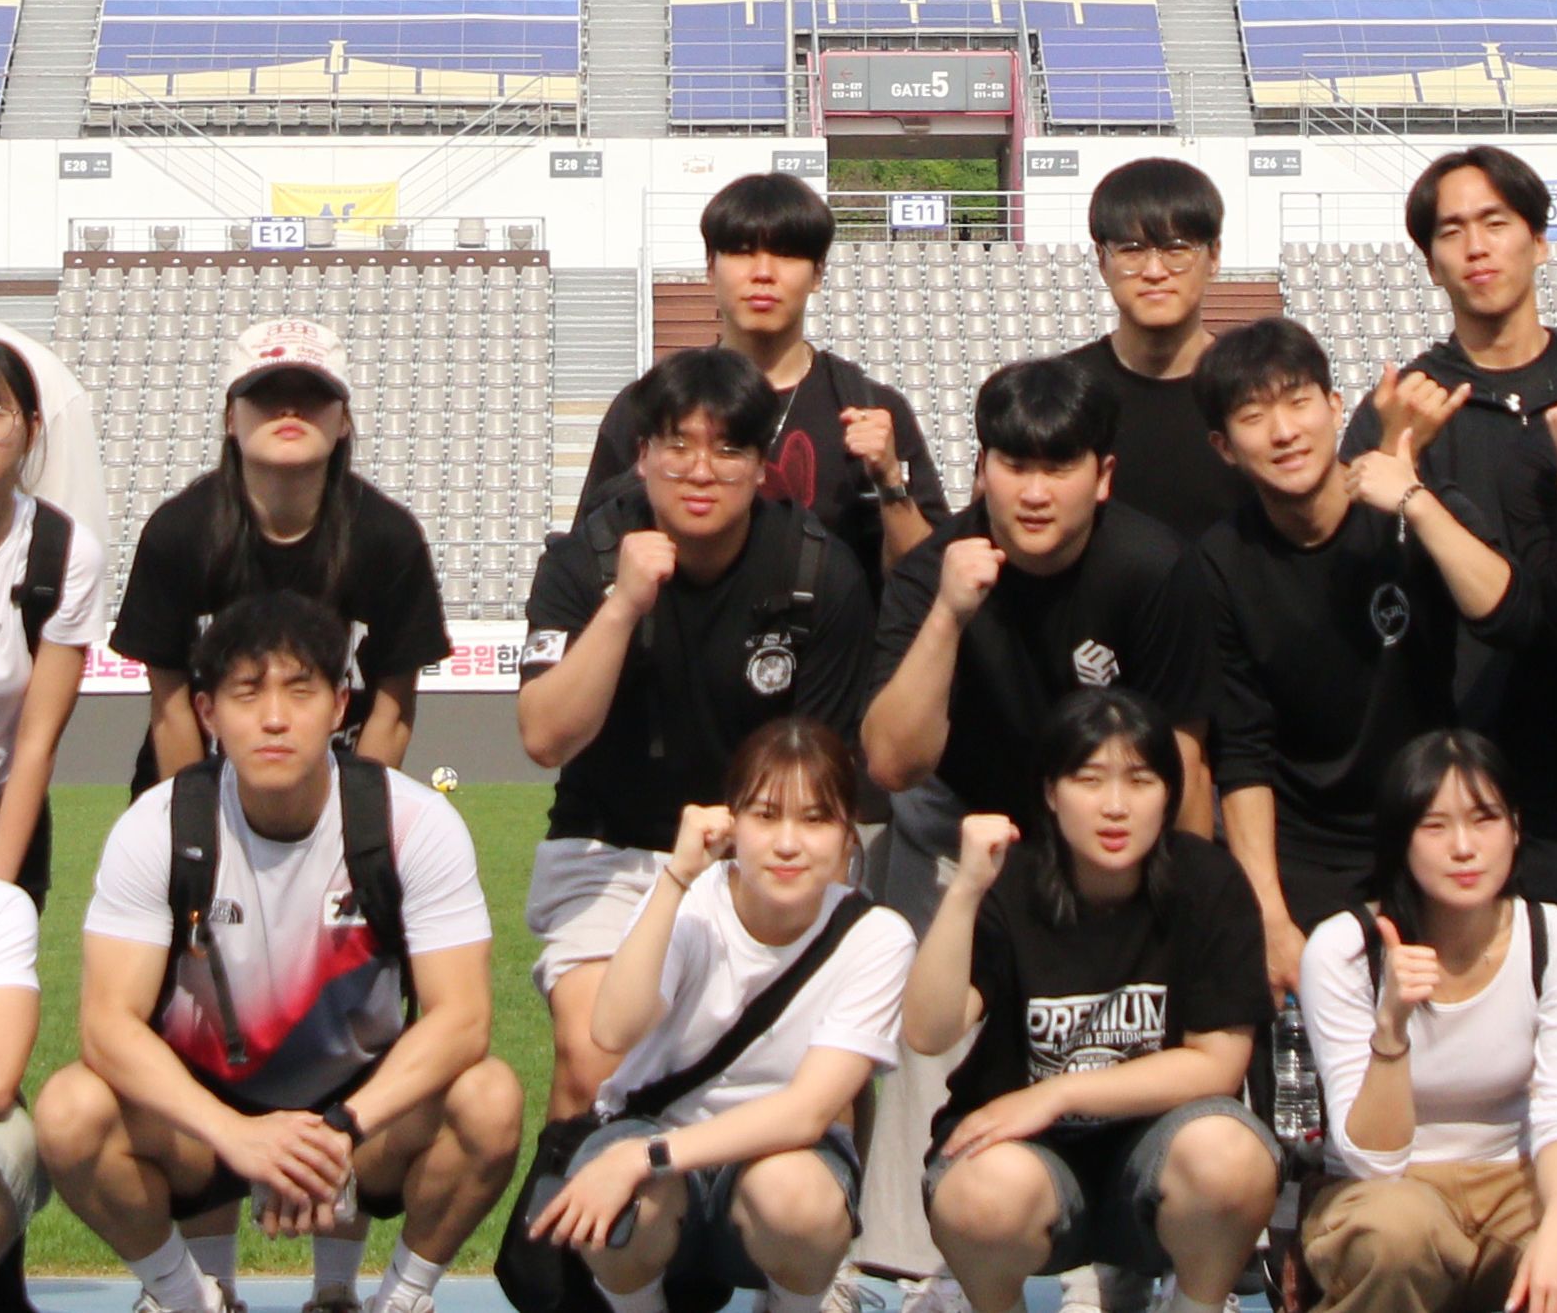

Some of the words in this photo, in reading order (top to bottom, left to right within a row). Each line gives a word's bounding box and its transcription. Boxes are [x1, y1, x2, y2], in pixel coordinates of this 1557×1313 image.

[776, 158, 801, 170] E27
[1031, 158, 1055, 170] E27
[1253, 157, 1278, 169] E26
[900, 203, 936, 222] E11
[259, 225, 298, 243] E12
[451, 644, 524, 676] 응원합
[1095, 1031, 1143, 1045] EDITION
